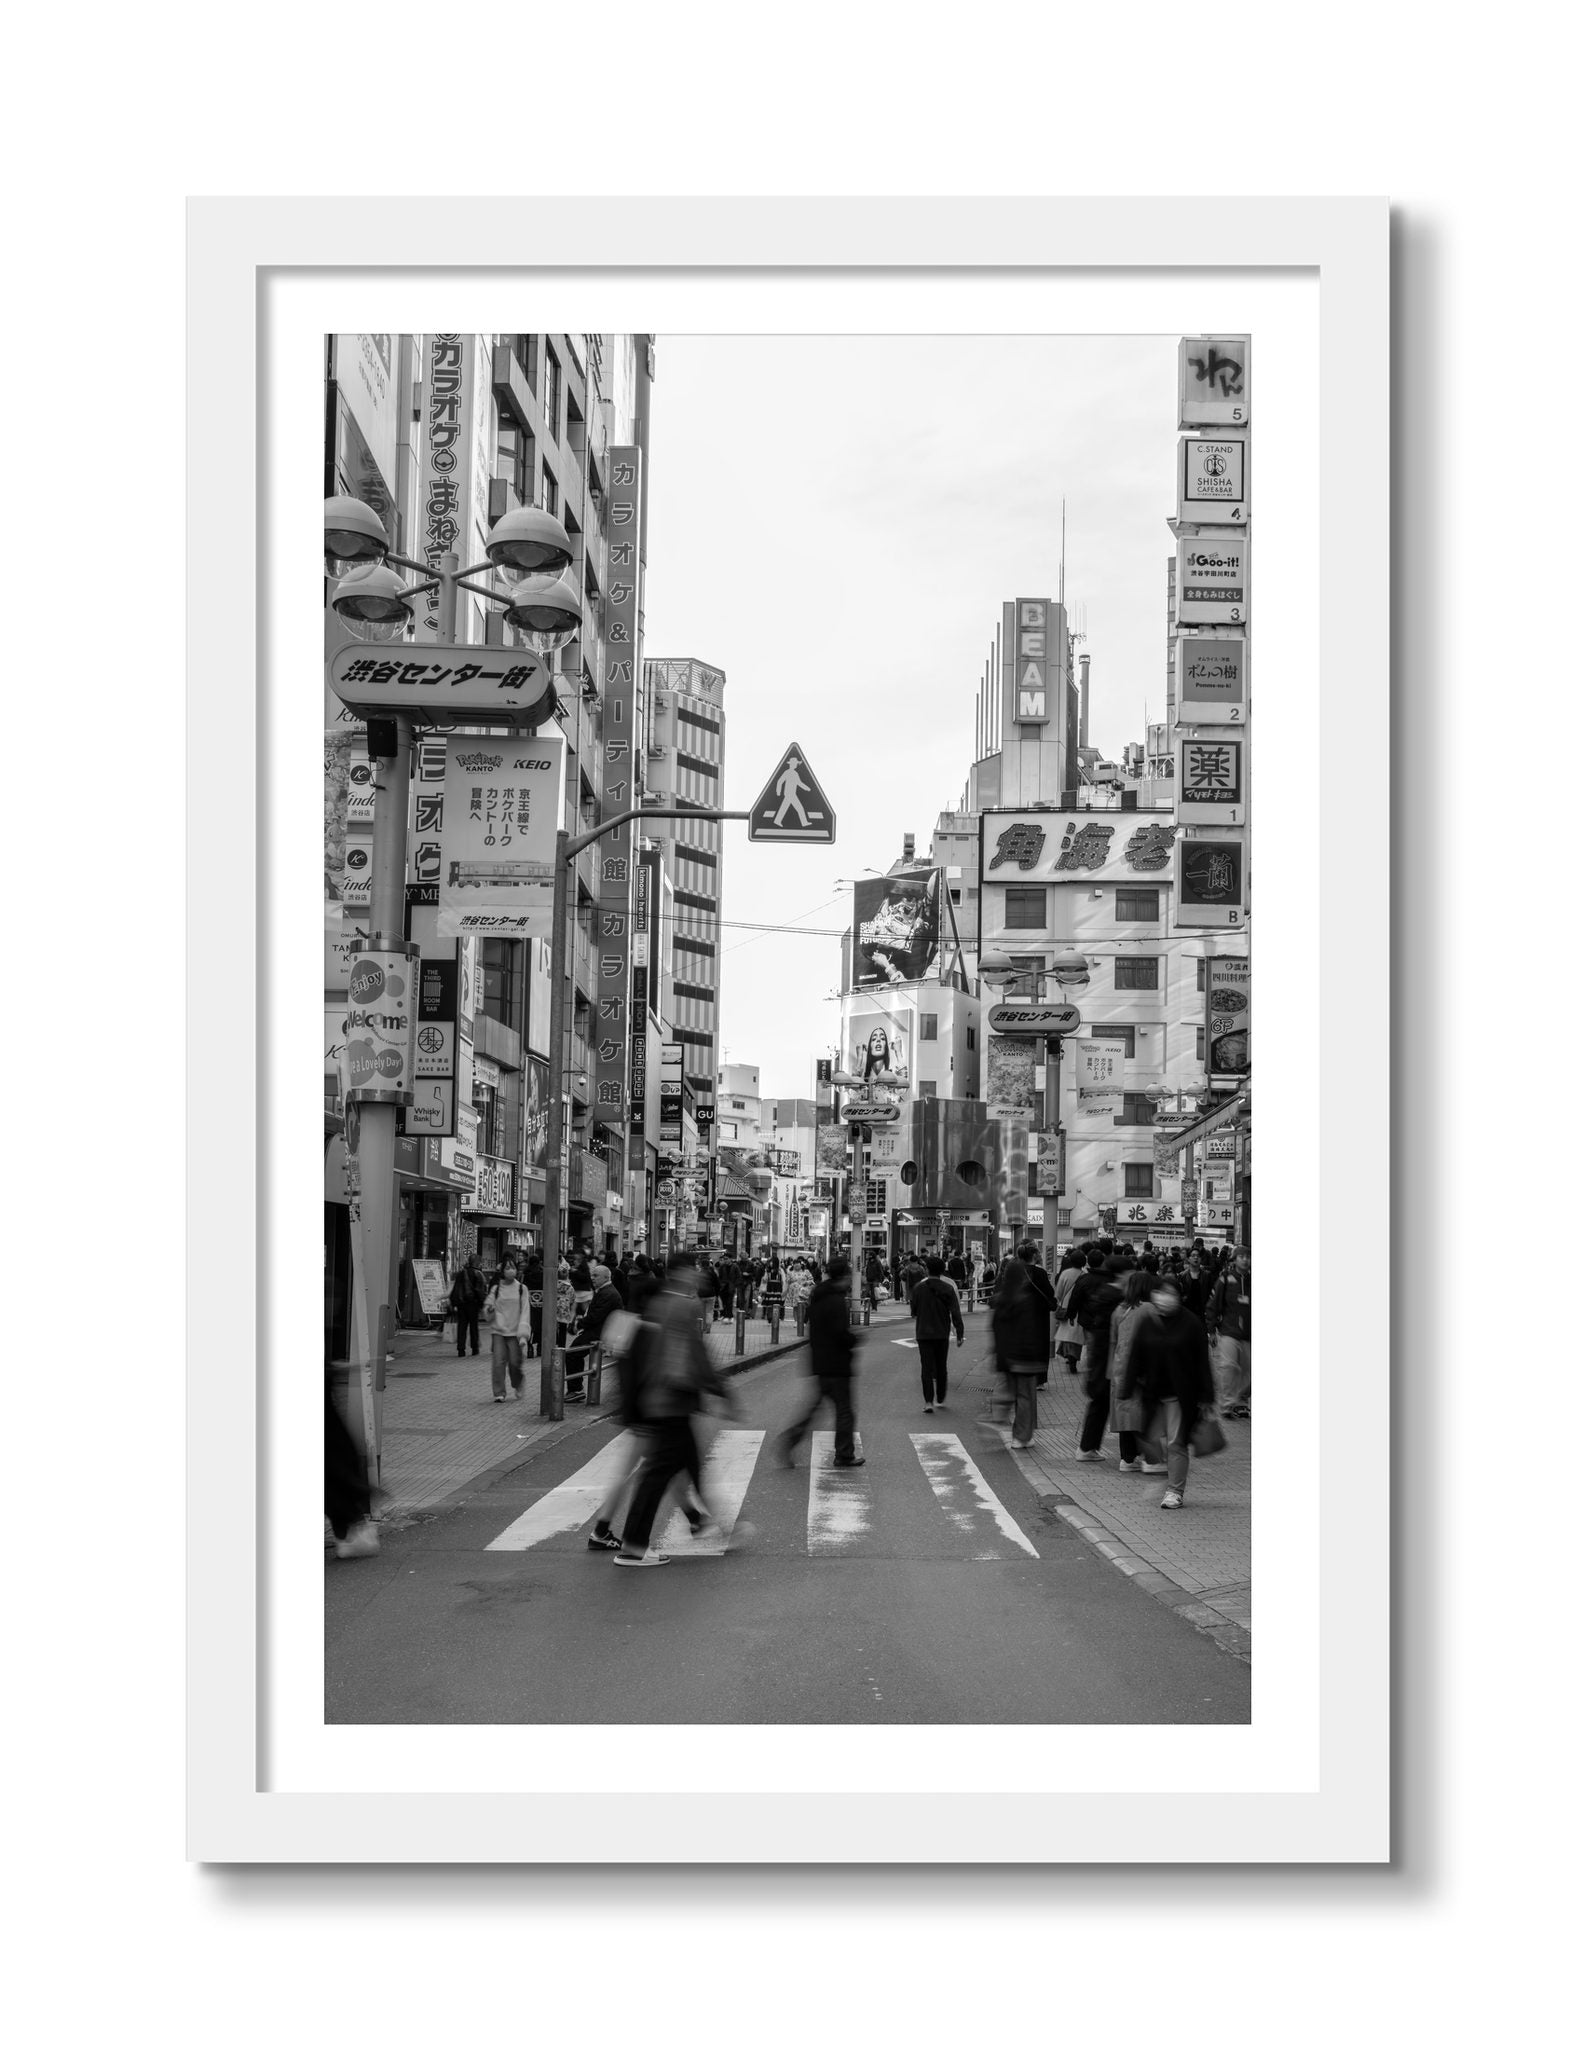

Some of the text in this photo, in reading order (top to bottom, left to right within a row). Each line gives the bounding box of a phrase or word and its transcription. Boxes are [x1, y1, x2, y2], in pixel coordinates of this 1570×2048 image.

[430, 341, 461, 450] カラオケ
[1233, 407, 1242, 420] 5
[1197, 477, 1233, 486] SHISHA
[1196, 554, 1239, 568] Goo-it!
[1187, 590, 1240, 600] 全身もみほぐし
[1230, 608, 1240, 621] 3
[1020, 602, 1047, 716] BEAM
[340, 659, 537, 689] 渋谷センター街
[1230, 708, 1239, 720] 2
[513, 759, 552, 771] KEIO
[1190, 746, 1230, 787] 薬
[1185, 789, 1235, 801] マツモトキヨシ
[469, 787, 483, 822] 冒険へ
[517, 788, 531, 836] 京王線で
[484, 787, 499, 847] カントーの
[1229, 809, 1237, 822] 1
[989, 823, 1176, 871] 角海老
[1186, 853, 1234, 891] 一蘭
[637, 869, 647, 898] kimono
[460, 916, 530, 926] 渋谷センター街
[1229, 910, 1238, 923] B
[351, 970, 383, 997] Enjoy
[598, 913, 626, 1106] カラオケ館
[994, 1011, 1075, 1022] 渋谷センター街
[348, 1010, 408, 1030] Welcome
[1211, 1018, 1234, 1034] 6F
[361, 1056, 385, 1072] Lovely
[386, 1054, 402, 1067] Day!
[414, 1108, 441, 1117] Whisky
[698, 1110, 714, 1119] GU
[1128, 1204, 1175, 1221] 兆楽
